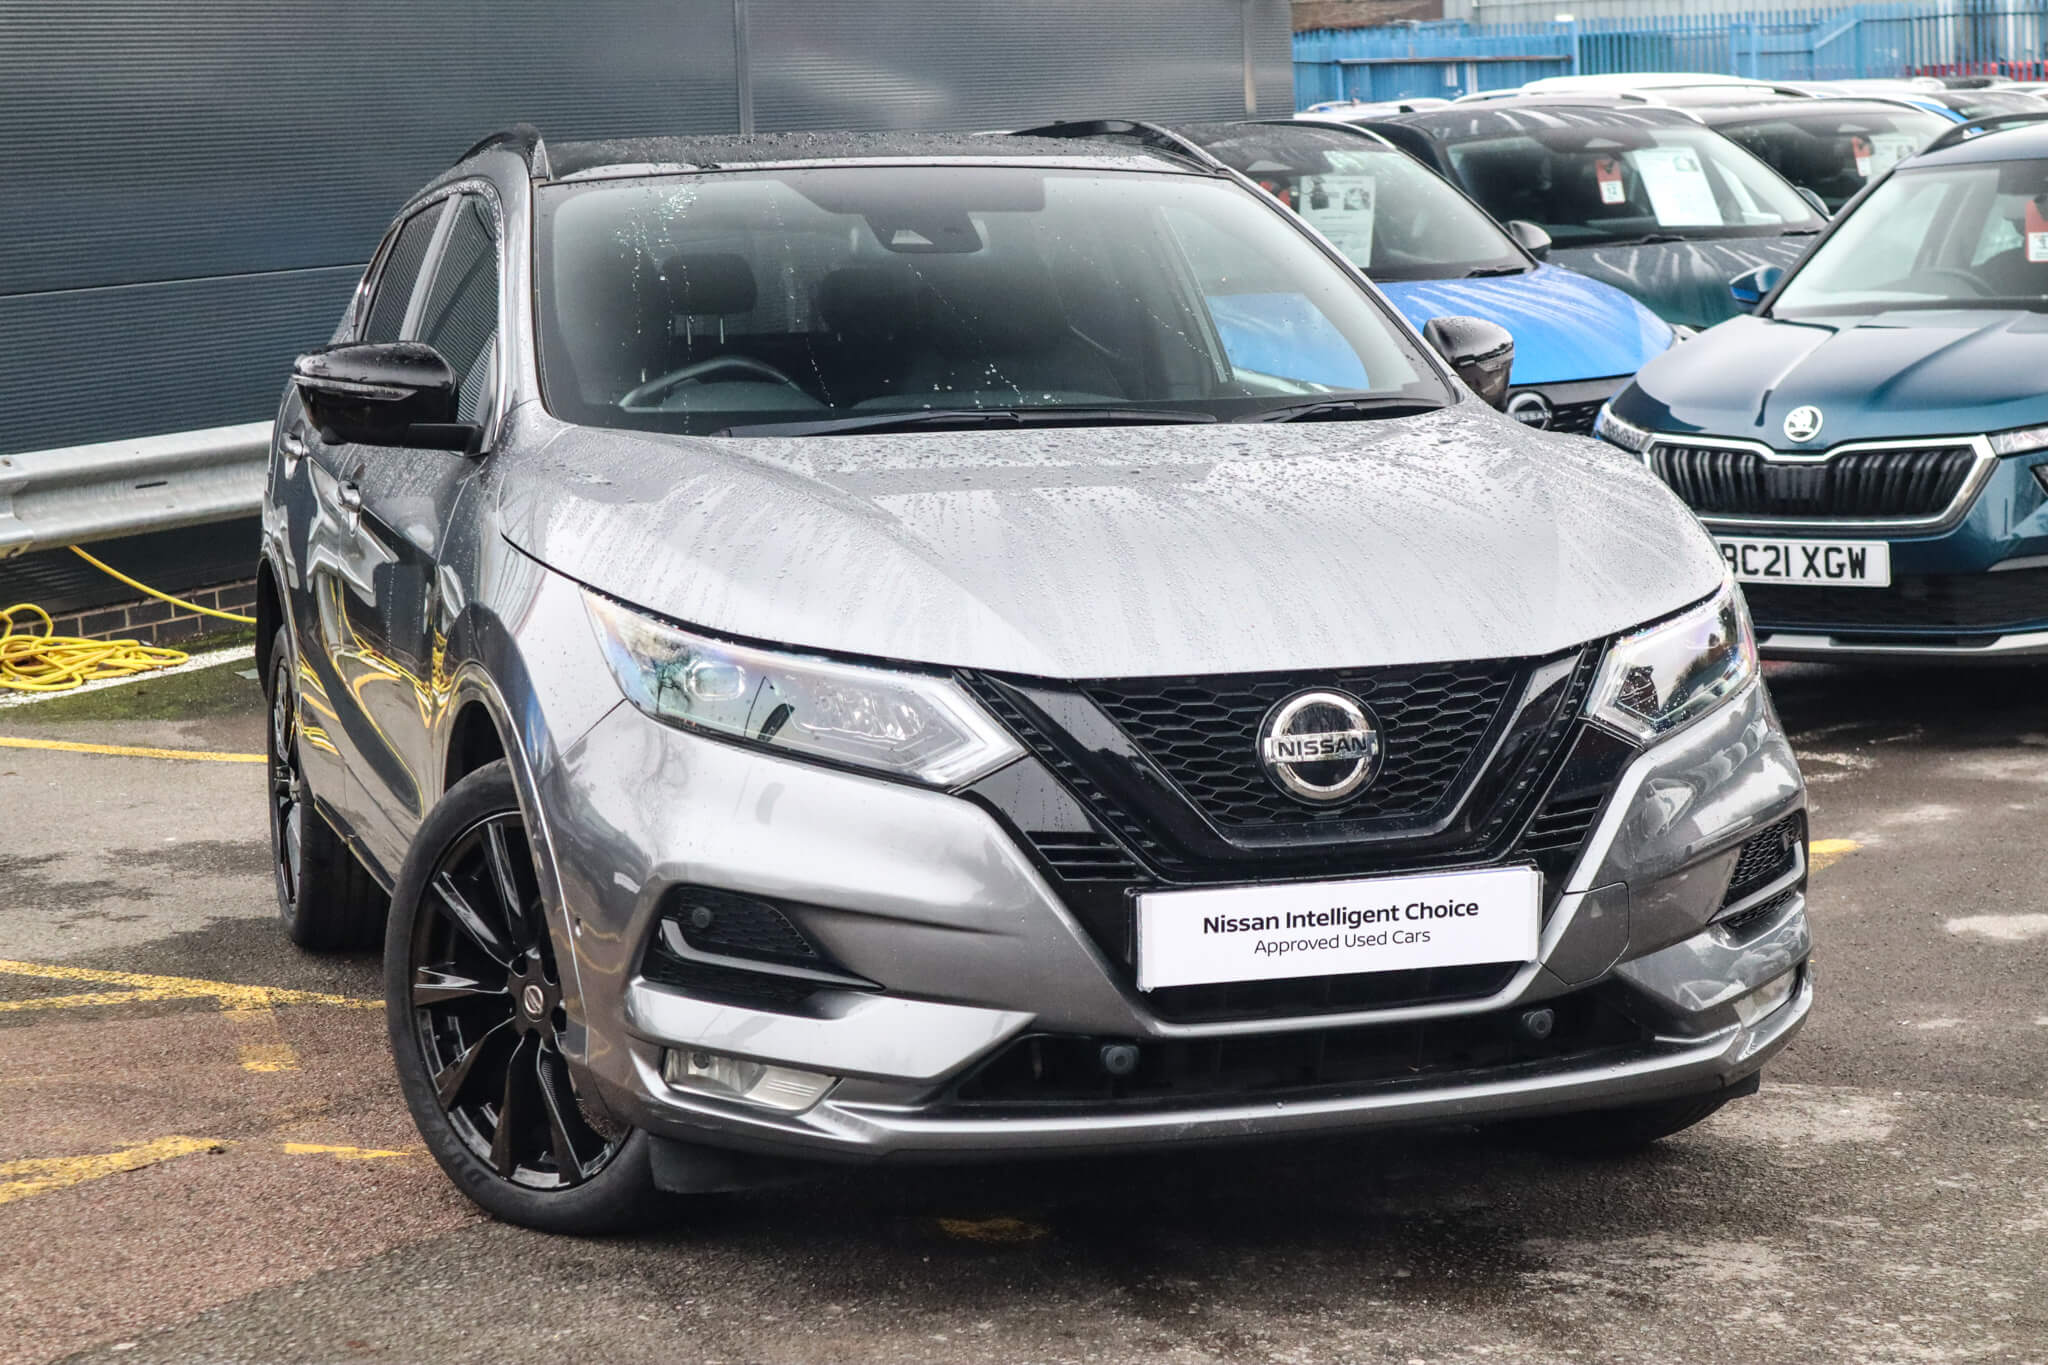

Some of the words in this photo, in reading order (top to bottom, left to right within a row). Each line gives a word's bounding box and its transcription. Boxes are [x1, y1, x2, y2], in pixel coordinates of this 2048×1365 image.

[1719, 543, 1791, 577] BC21
[1801, 546, 1867, 579] XGW
[1278, 736, 1367, 757] NISSAN
[1203, 914, 1280, 934] Nissan
[1286, 905, 1400, 929] Intelligent
[1405, 899, 1480, 921] Choice
[1253, 934, 1340, 957] Approved
[1344, 930, 1388, 949] Used
[1392, 929, 1431, 945] Cars
